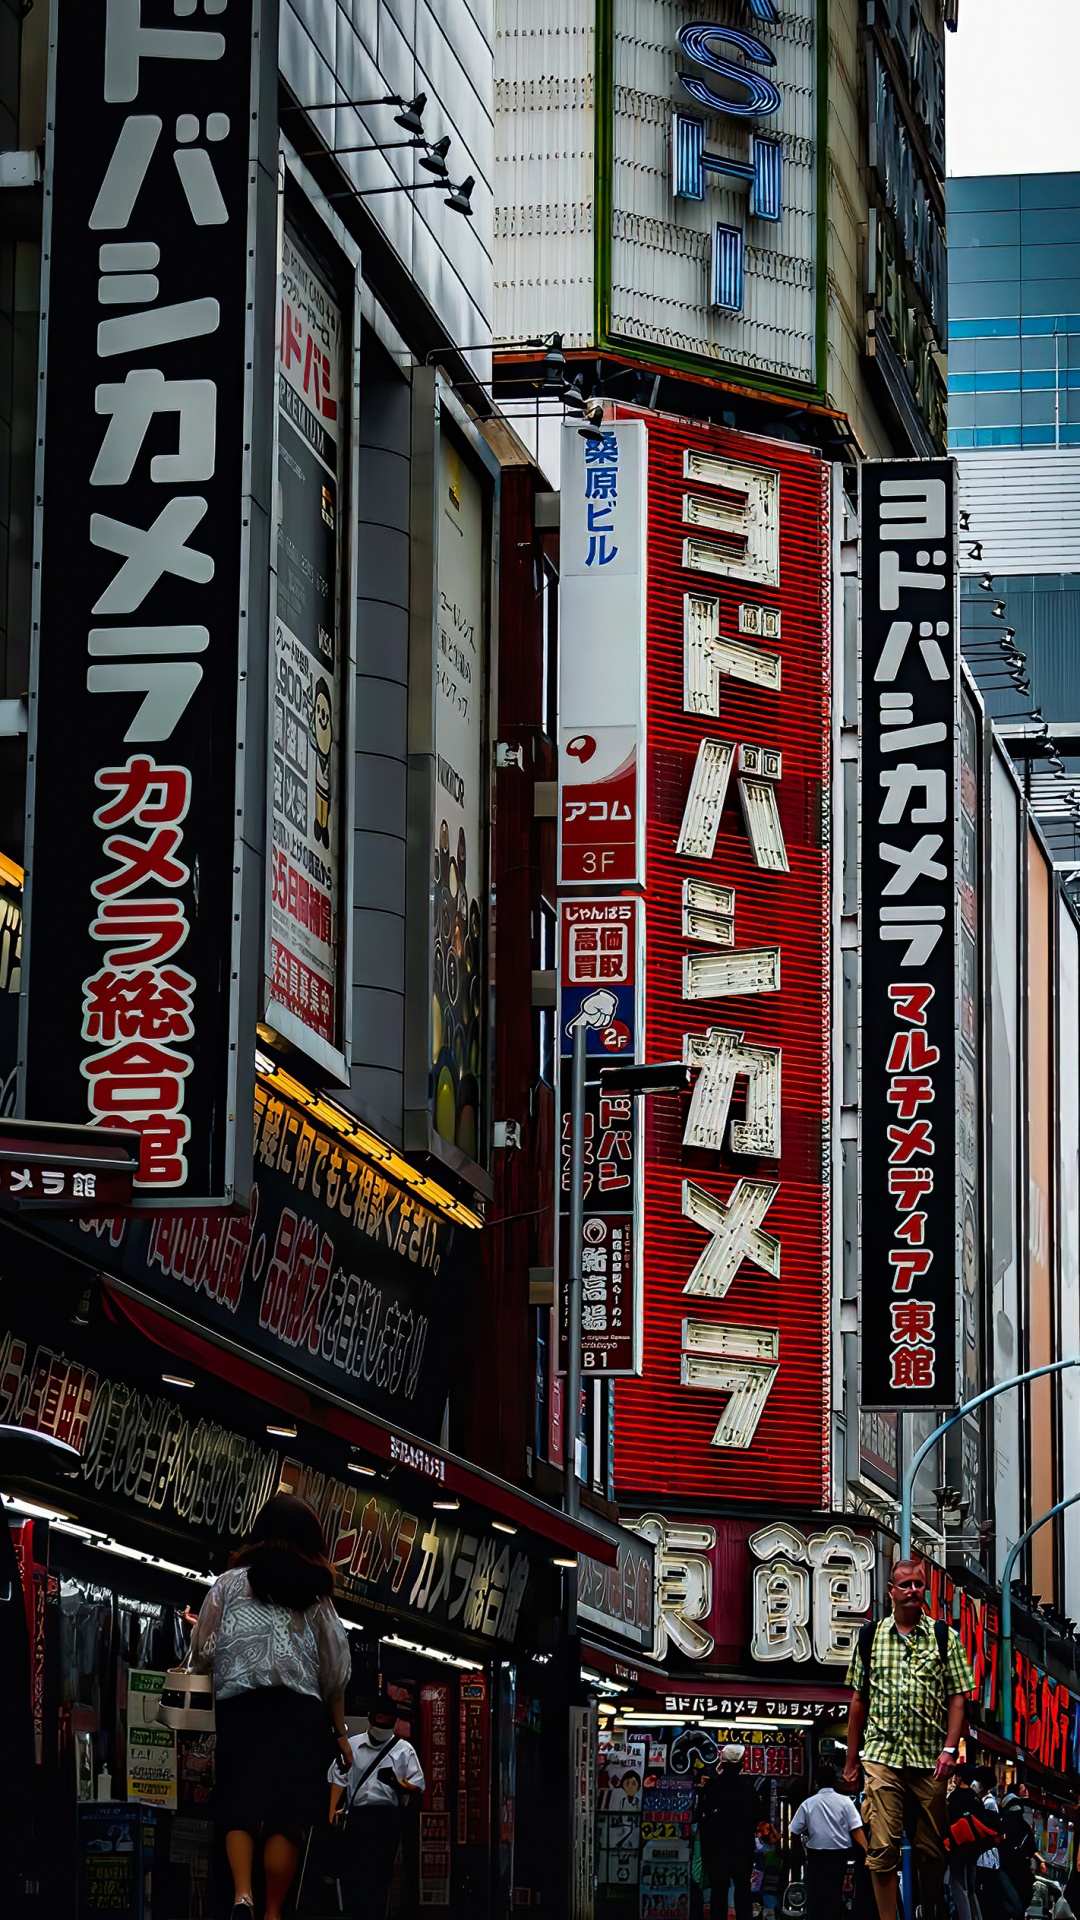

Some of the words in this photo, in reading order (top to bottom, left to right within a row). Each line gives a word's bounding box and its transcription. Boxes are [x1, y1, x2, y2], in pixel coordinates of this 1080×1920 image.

[672, 0, 782, 311] SHI
[87, 0, 230, 742] ドバシカメラ
[281, 298, 337, 421] ドバシ
[584, 431, 619, 567] 桑原ビル
[874, 479, 950, 966] ヨドバシカメラ
[565, 800, 632, 822] アコム
[582, 851, 615, 873] 3F
[80, 753, 196, 1190] カメラ総合館
[565, 905, 632, 921] じゃんぱら
[574, 926, 623, 951] 高価
[574, 954, 623, 979] 買取
[676, 449, 789, 1448] ヨドバシカメラ
[604, 1028, 628, 1048] 2F
[886, 982, 940, 1390] マルチメディア東館
[584, 1351, 608, 1368] B1
[618, 1512, 876, 1666] 東館
[665, 1697, 758, 1715] ヨドバシカメラ
[766, 1701, 849, 1717] マルチメディア
